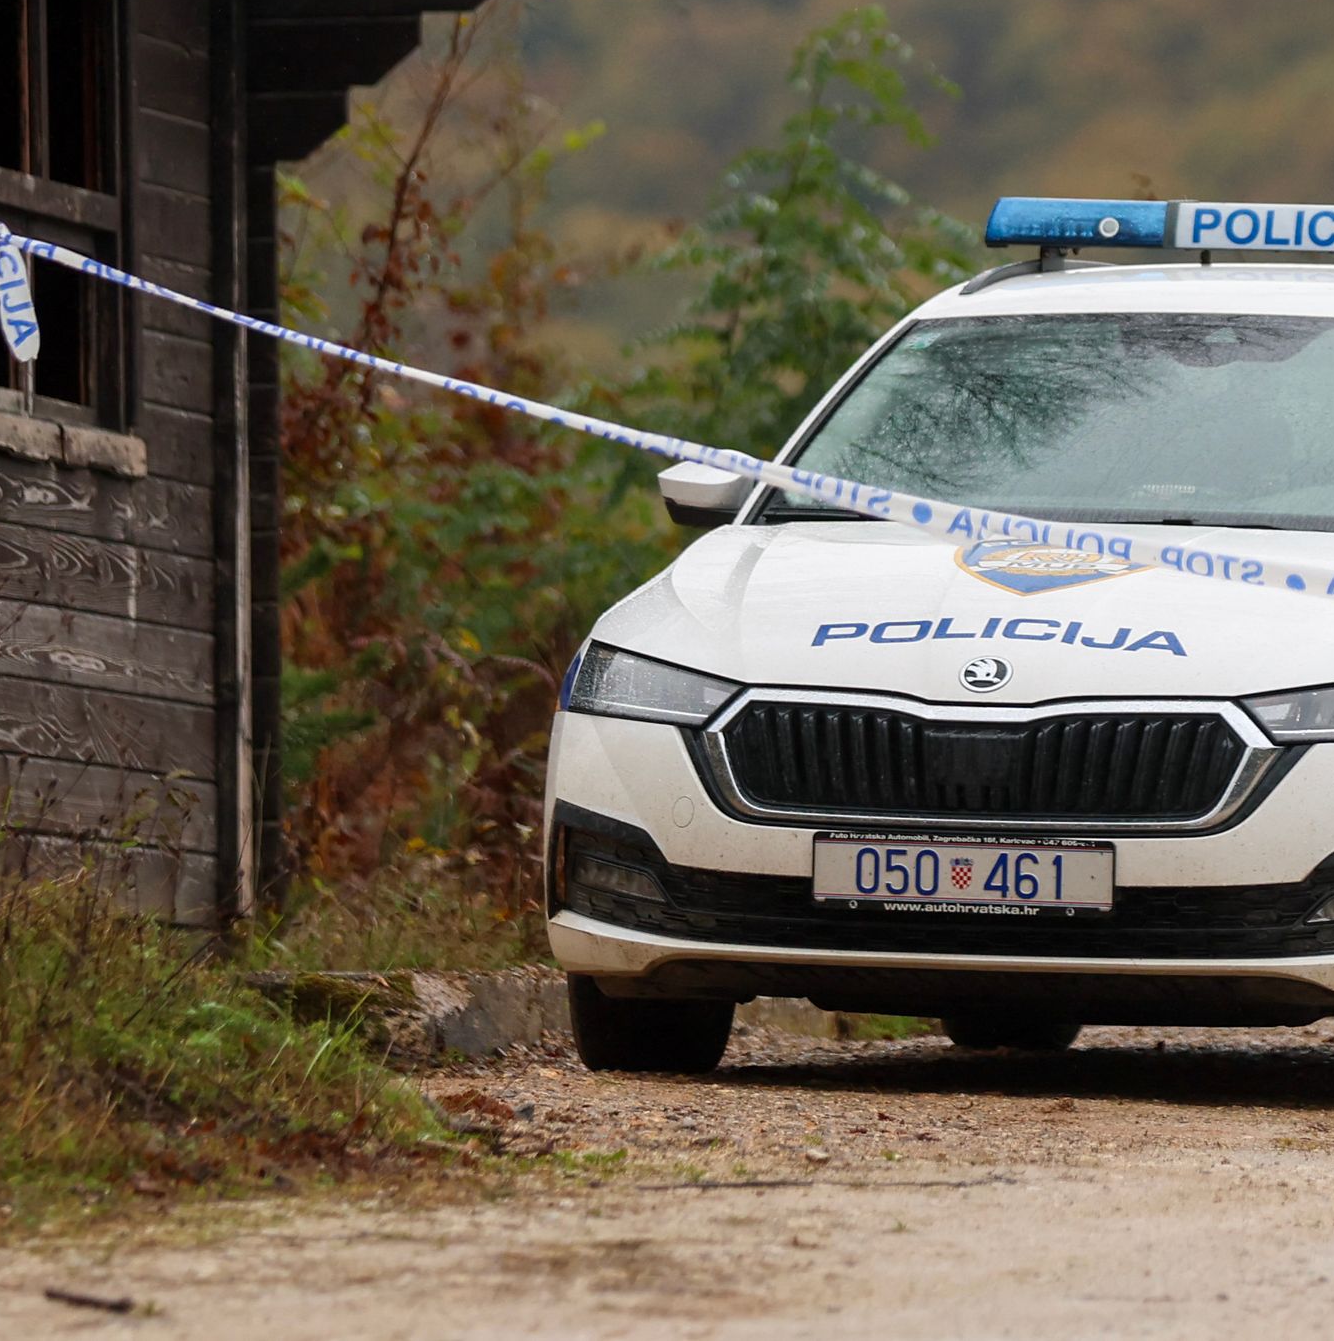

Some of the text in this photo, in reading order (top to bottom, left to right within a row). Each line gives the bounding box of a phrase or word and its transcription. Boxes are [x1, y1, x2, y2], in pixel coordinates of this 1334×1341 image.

[809, 617, 1189, 657] POLICIJA
[855, 847, 1063, 901] 050 461
[883, 900, 1040, 917] www.autohrvatska.hr
